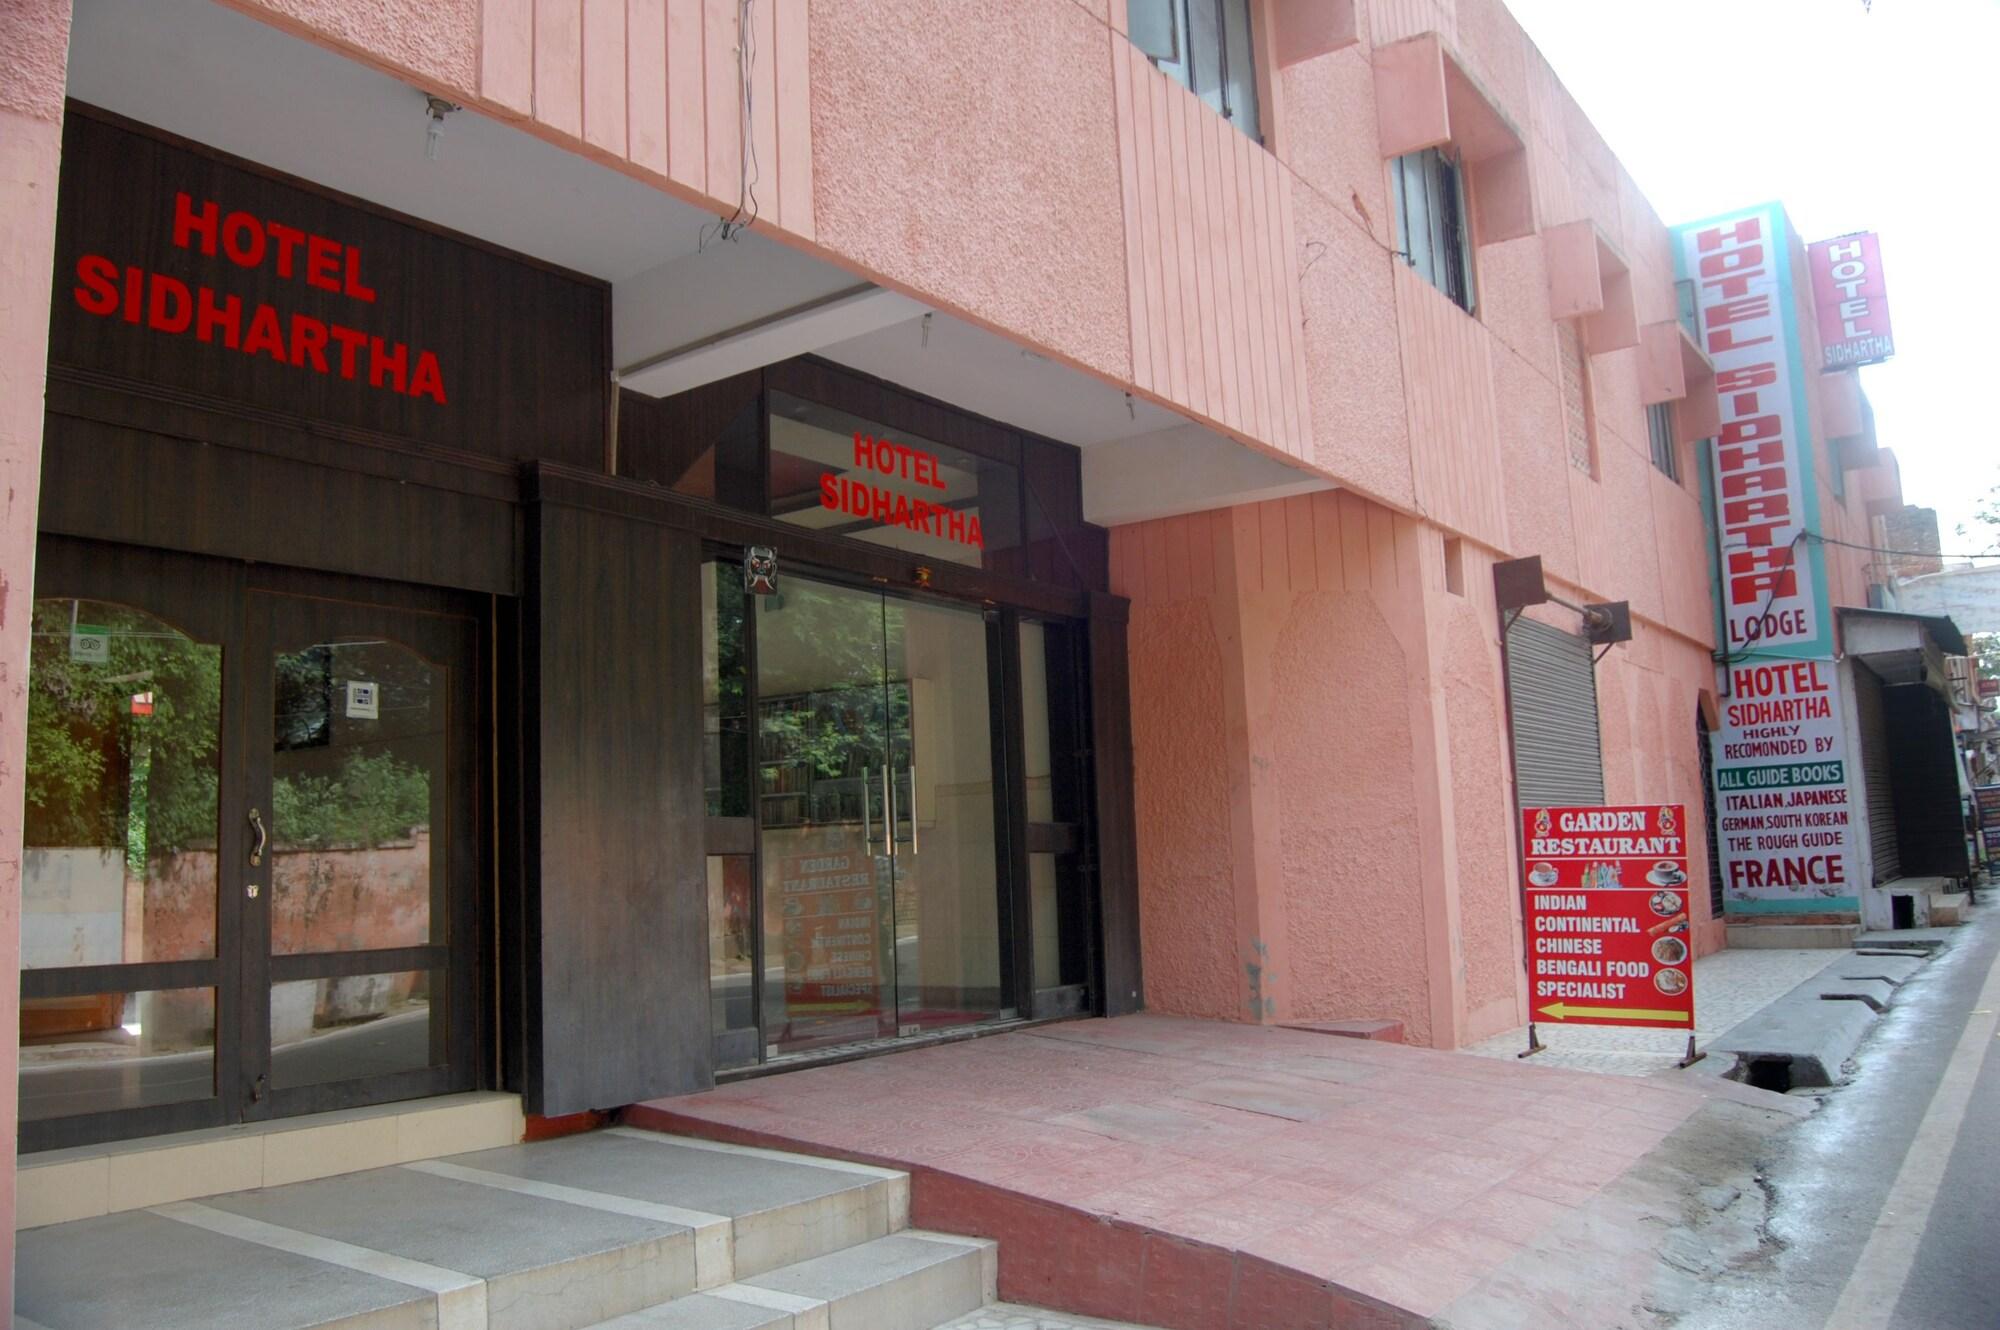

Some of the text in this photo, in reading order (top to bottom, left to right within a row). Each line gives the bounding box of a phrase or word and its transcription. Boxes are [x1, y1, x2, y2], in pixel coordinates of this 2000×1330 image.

[172, 191, 376, 303] HOTEL
[1697, 217, 1773, 355] HOTEL
[1829, 239, 1872, 339] HOTEL
[74, 254, 448, 405] SIDHARTHA
[1824, 335, 1892, 364] SIDHARTHA
[853, 431, 947, 490] HOTEL
[1716, 362, 1797, 605] SIDHARTHA
[818, 472, 984, 549] SIDHARTHA
[1730, 609, 1807, 643] LODGE
[1734, 662, 1828, 699] HOTEL
[1727, 696, 1831, 727] SIDHARTHA
[1743, 725, 1800, 739] HIGHLY
[1725, 736, 1833, 760] RECOMONDED BY
[1720, 764, 1840, 788] ALL GUIDE BOOKS
[1560, 812, 1645, 832] GARDEN
[1805, 811, 1848, 826] KOREAN
[1531, 837, 1680, 855] RESTAURANT
[1728, 831, 1843, 852] THE ROUGH GUIDE
[1729, 854, 1845, 889] FRANCE
[1534, 895, 1587, 910] INDIAN
[1535, 917, 1640, 933] CONTINENTAL
[1536, 938, 1602, 954] CHINESE
[1537, 959, 1649, 977] BENGALI FOOD
[1537, 981, 1626, 999] SPECIALIST
